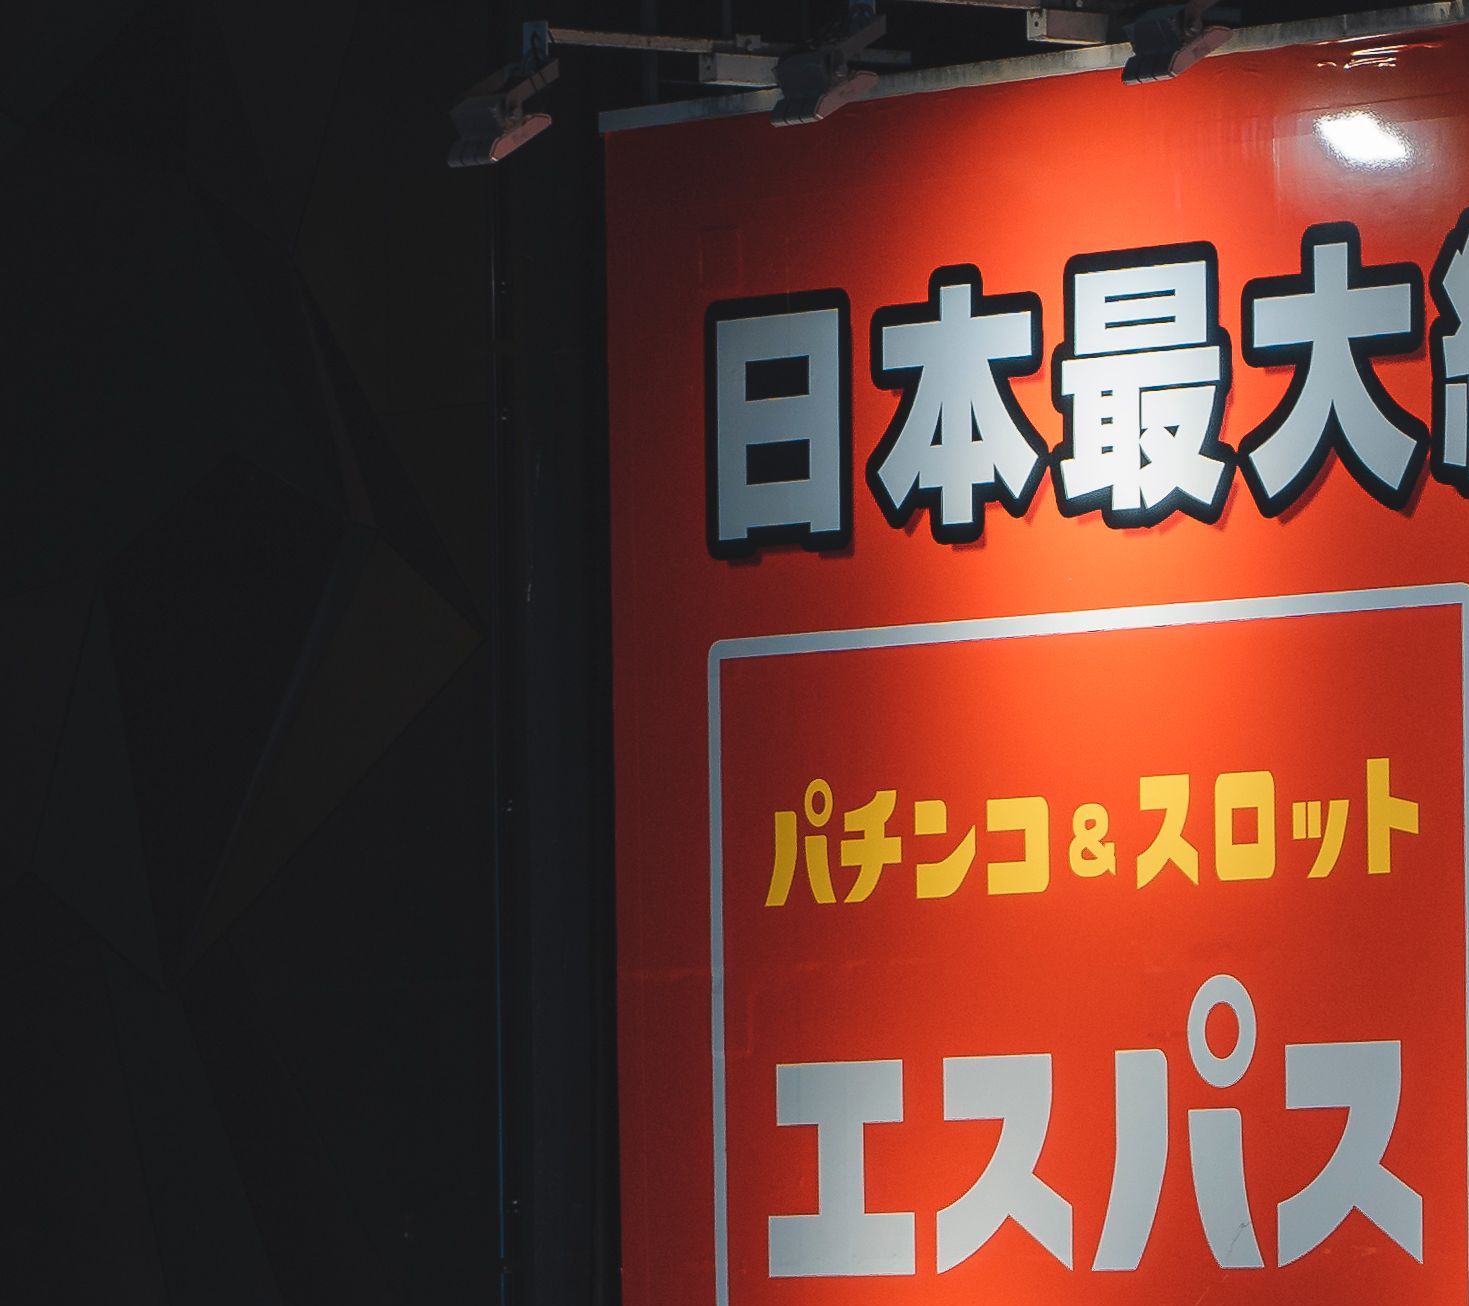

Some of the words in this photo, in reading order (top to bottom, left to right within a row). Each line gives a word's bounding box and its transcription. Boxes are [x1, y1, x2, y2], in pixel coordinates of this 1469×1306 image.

[764, 757, 1418, 908] パチンコ&スロット
[767, 974, 1423, 1277] エスパス
